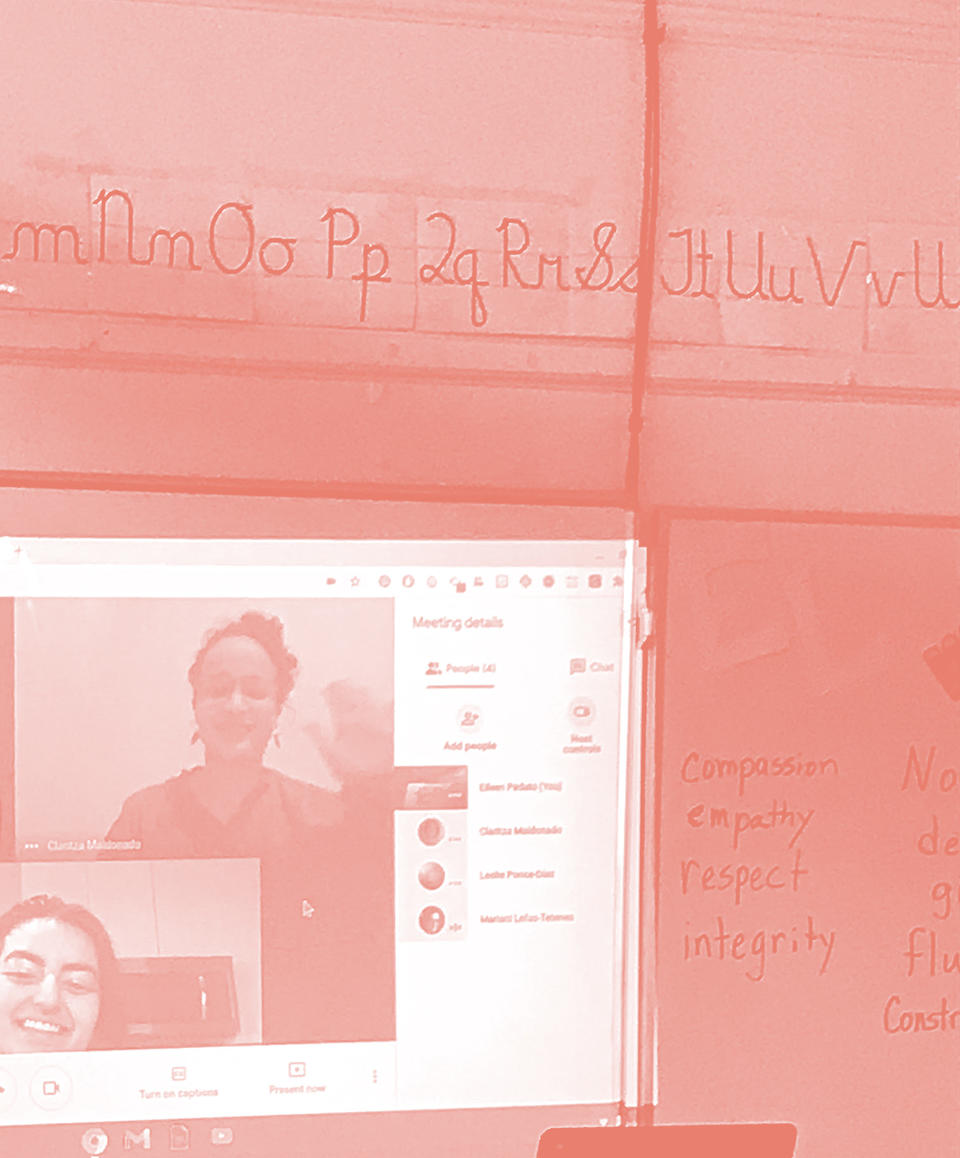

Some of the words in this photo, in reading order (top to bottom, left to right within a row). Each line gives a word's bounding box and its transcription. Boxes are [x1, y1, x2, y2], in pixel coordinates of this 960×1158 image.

[209, 201, 297, 276] Oo
[320, 207, 392, 322] Pp
[496, 217, 570, 292] Rr
[806, 237, 906, 307] Vv
[412, 615, 463, 632] Meeting
[464, 615, 504, 629] details
[445, 662, 480, 675] People
[589, 662, 615, 672] Chat
[443, 740, 463, 751] Add
[464, 741, 497, 752] people
[681, 751, 839, 797] Compassion
[686, 799, 816, 850] empathy
[680, 848, 809, 905] respect
[683, 915, 837, 983] integrity
[138, 1089, 162, 1100] Turn
[268, 1083, 305, 1094] Present
